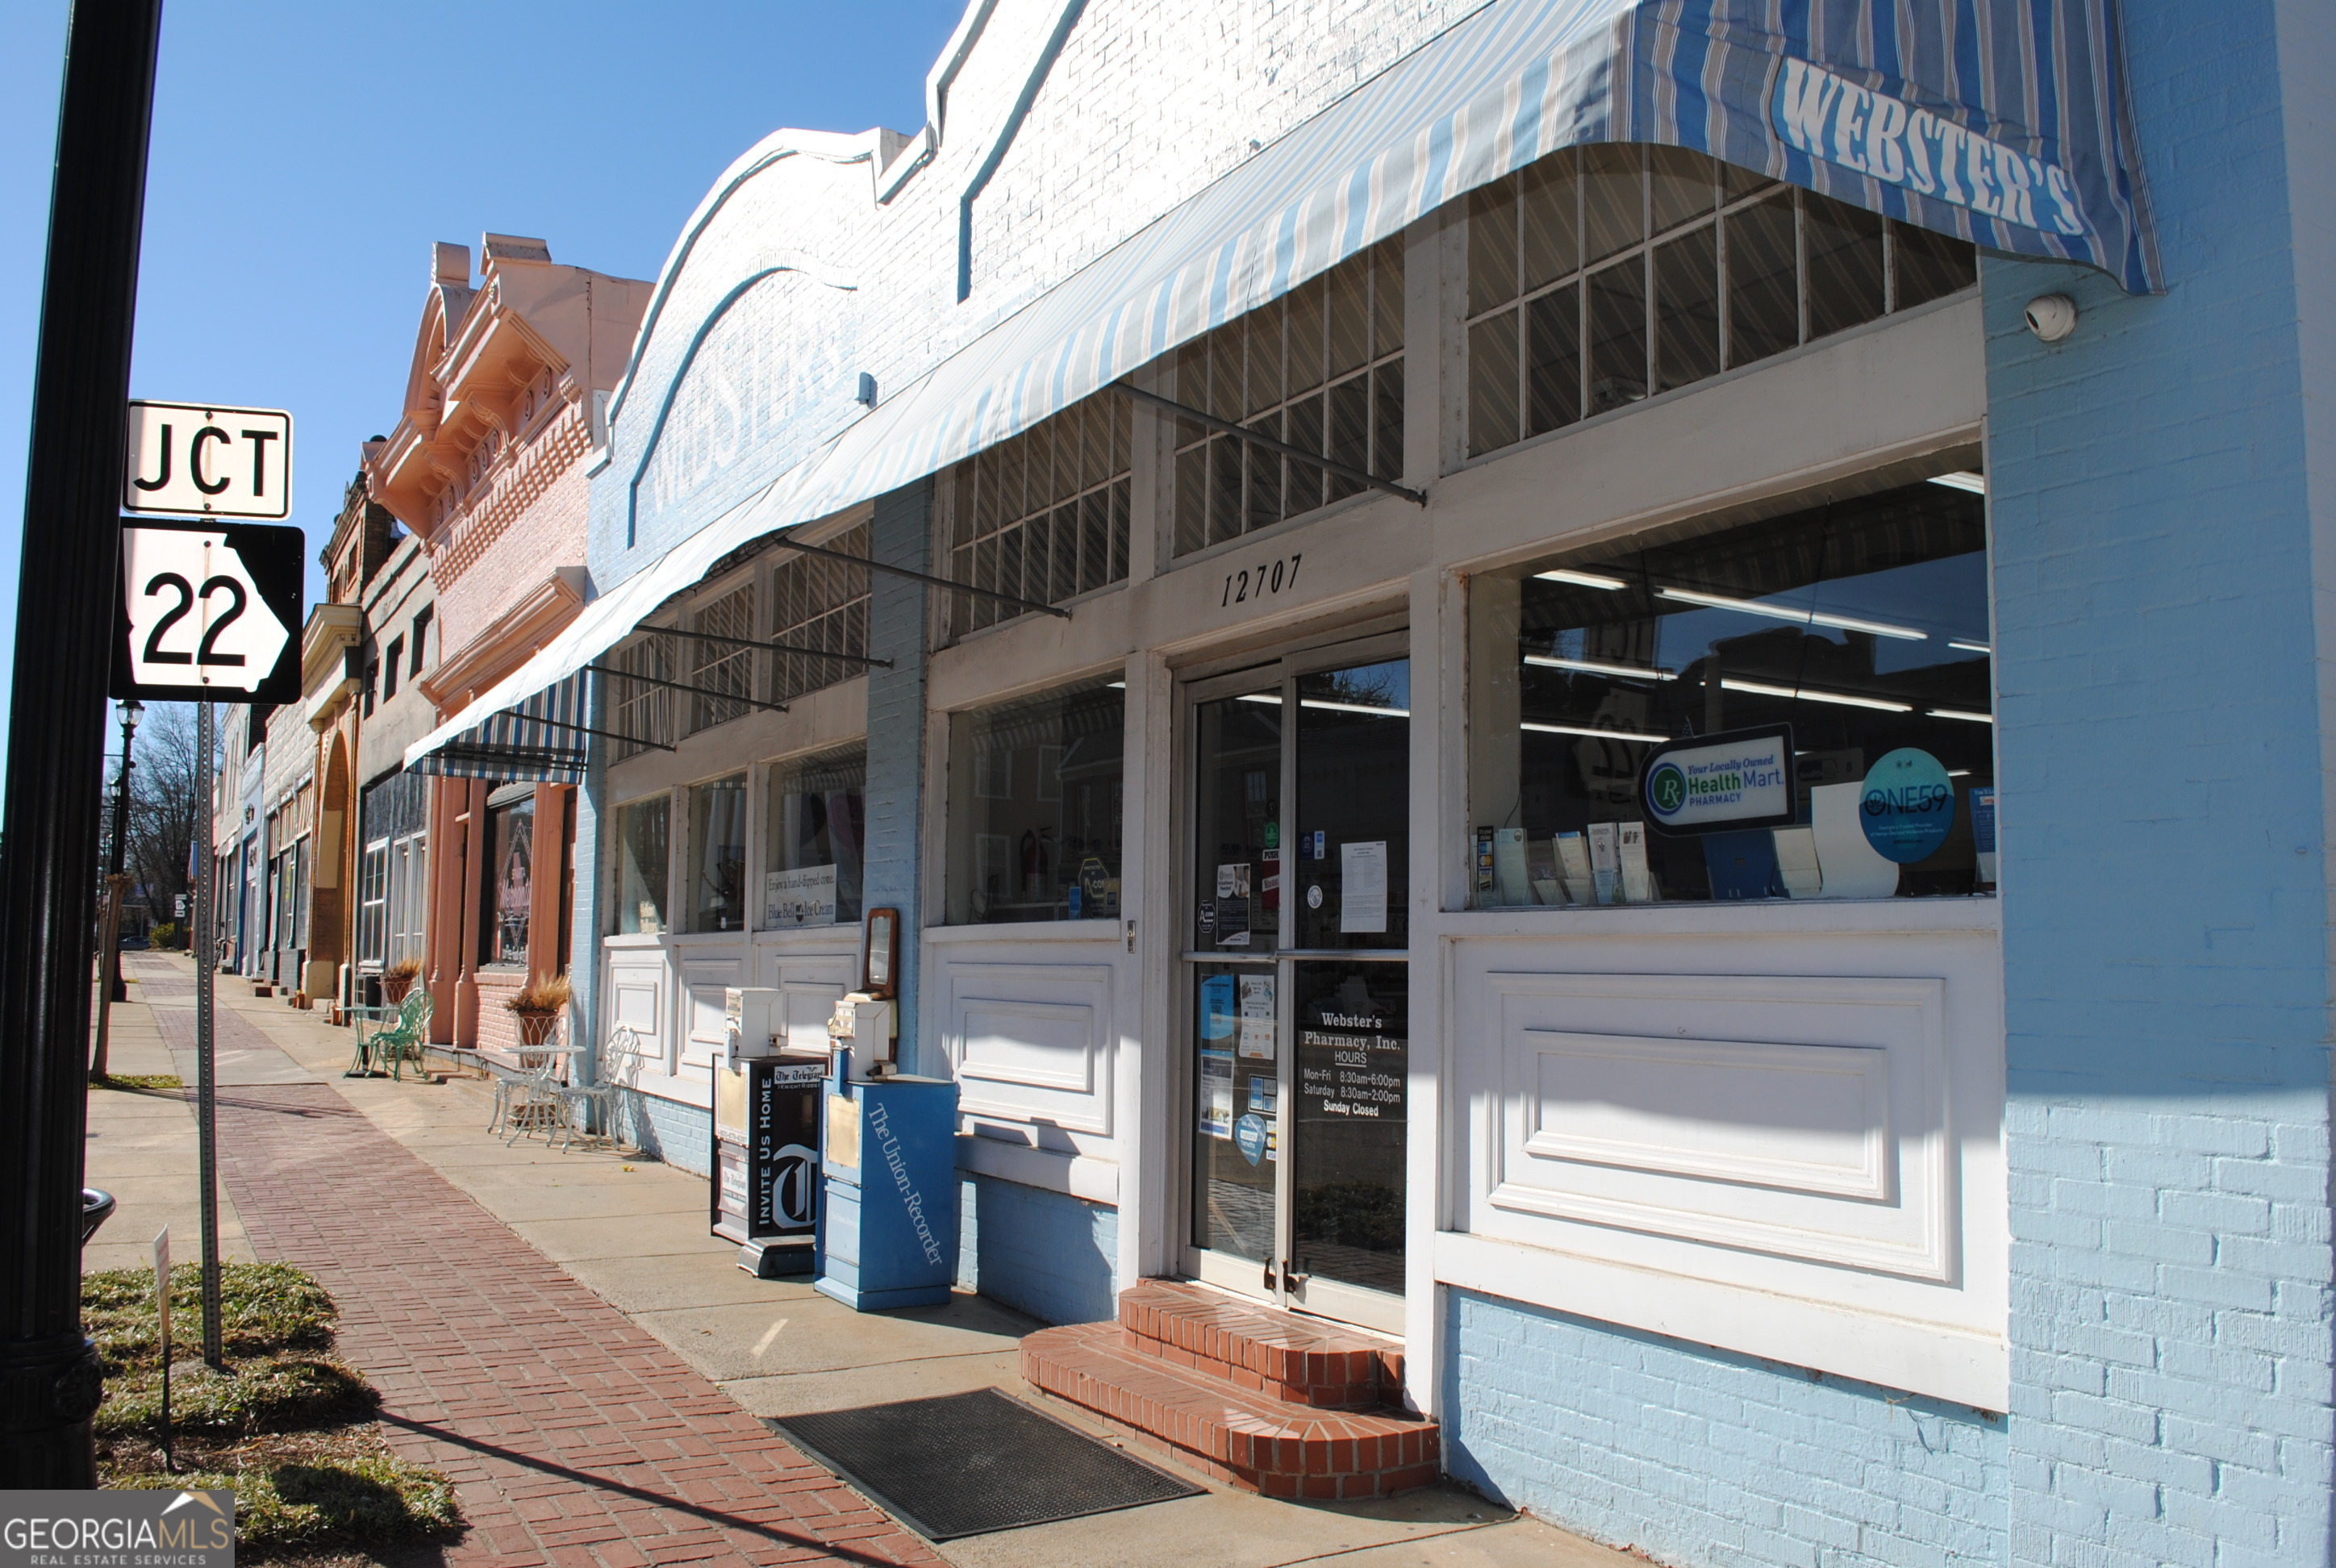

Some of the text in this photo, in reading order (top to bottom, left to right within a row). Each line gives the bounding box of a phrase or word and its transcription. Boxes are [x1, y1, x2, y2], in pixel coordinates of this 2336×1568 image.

[1782, 56, 2084, 236] WEBSTER'S
[133, 423, 278, 497] JCT
[1221, 552, 1302, 607] 12707
[142, 572, 247, 667] 22
[1687, 754, 1774, 775] Your Locally Owned
[1688, 773, 1742, 794] Health
[1689, 792, 1742, 807] PHARMACY
[1864, 784, 1948, 816] ONE59
[1264, 850, 1279, 860] PUSH
[769, 878, 784, 892] Enjoy
[768, 899, 833, 920] Blue Bell Ice Cream
[1321, 1012, 1383, 1028] Webster's
[1304, 1031, 1400, 1051] Pharmacy, Inc.
[1335, 1050, 1367, 1064] HOURS
[775, 1070, 790, 1082] The
[1304, 1068, 1400, 1089] Mon-Fri 8:30am-6:00pm
[1304, 1082, 1400, 1104] Saturday 8:30am-2:00pm
[1324, 1099, 1379, 1117] Sunday Closed
[759, 1078, 772, 1225] INVITE US HOME
[868, 1103, 943, 1266] The Union-Recorder
